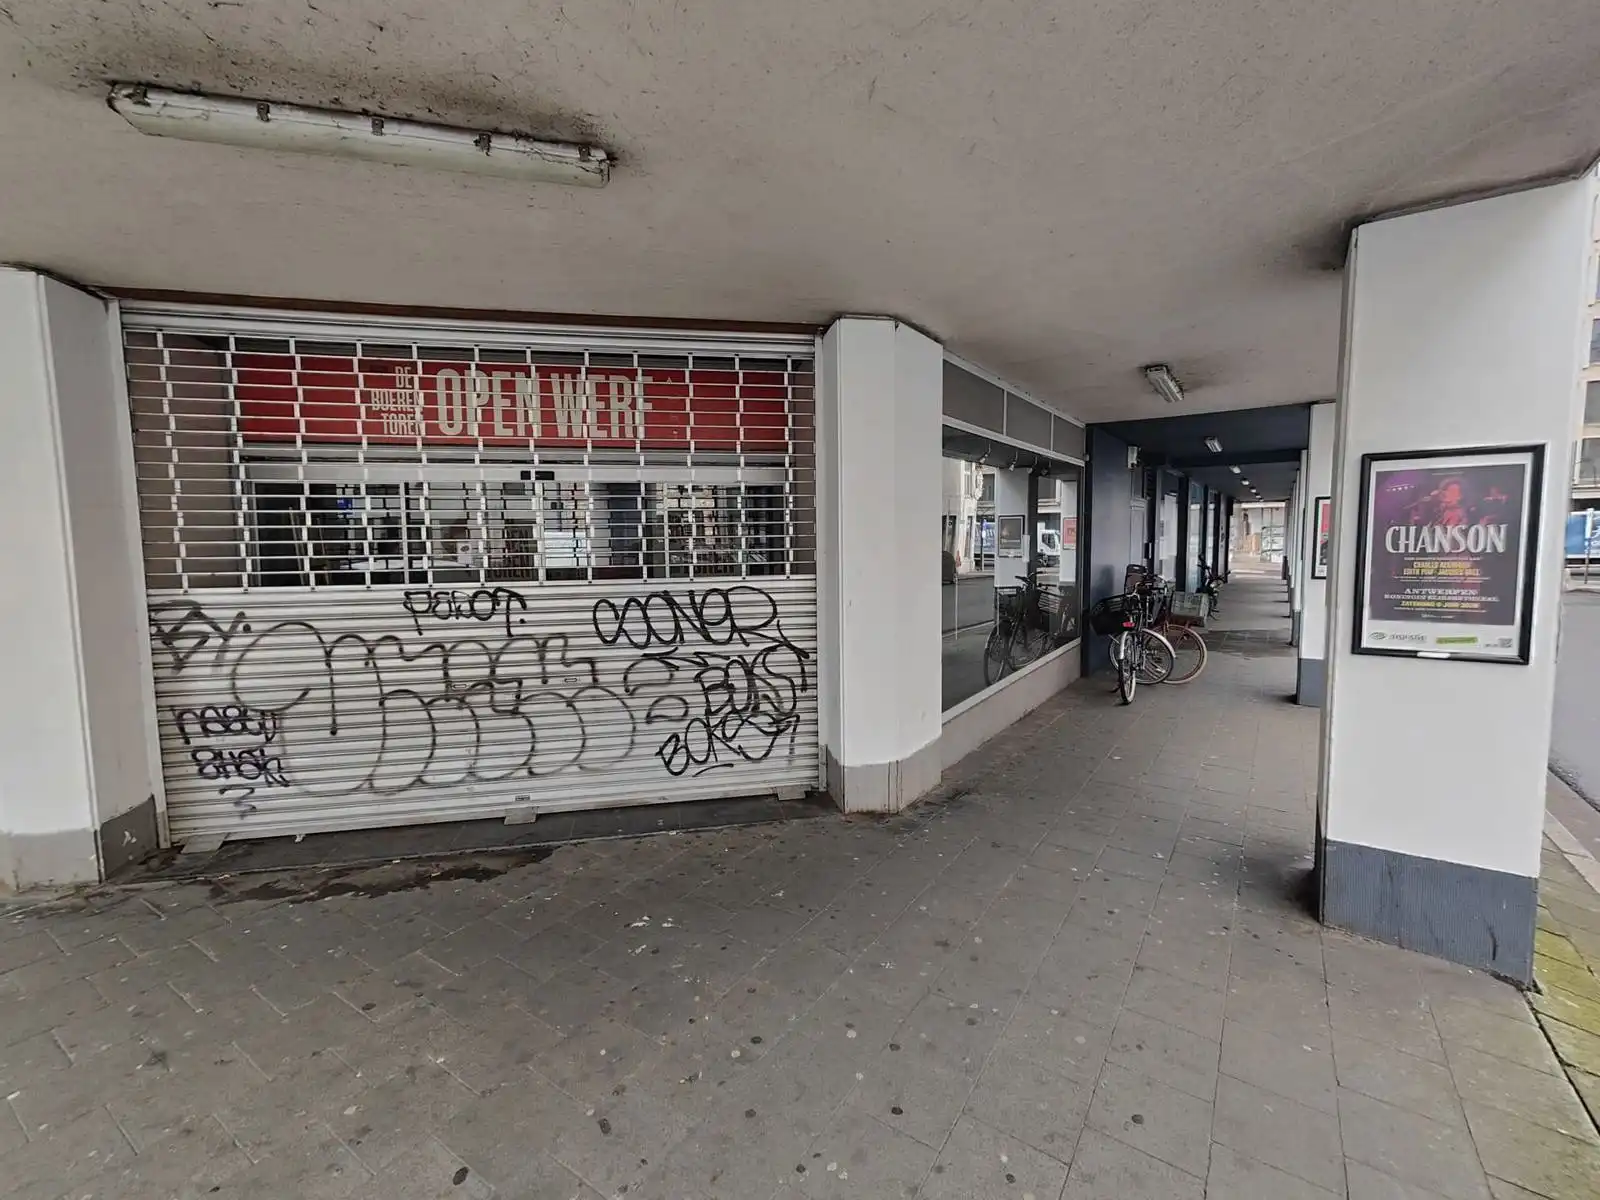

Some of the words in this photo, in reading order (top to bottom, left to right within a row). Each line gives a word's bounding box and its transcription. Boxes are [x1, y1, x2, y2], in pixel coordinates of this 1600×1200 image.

[371, 390, 423, 411] BOEREN
[436, 368, 542, 438] OPEN
[550, 373, 653, 439] WERF
[381, 412, 426, 435] TOREN
[1385, 524, 1508, 553] CHANSON
